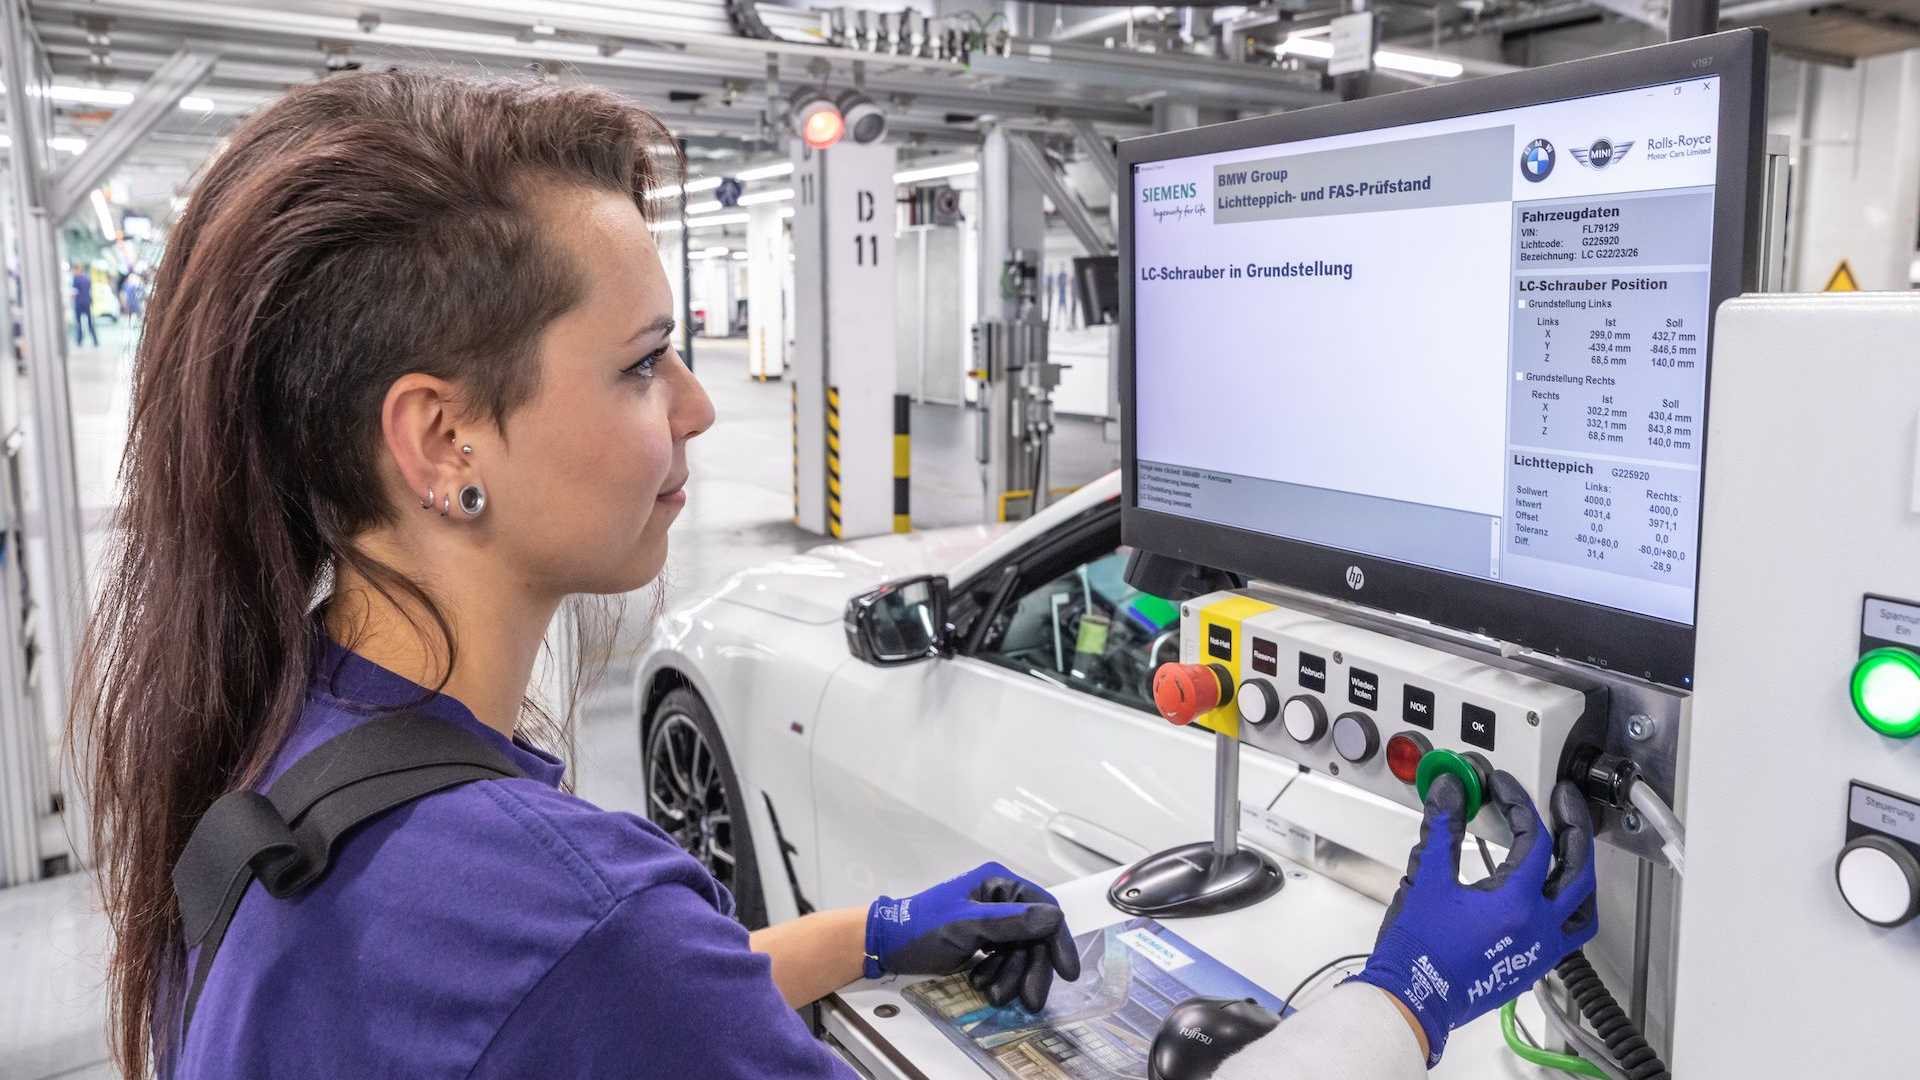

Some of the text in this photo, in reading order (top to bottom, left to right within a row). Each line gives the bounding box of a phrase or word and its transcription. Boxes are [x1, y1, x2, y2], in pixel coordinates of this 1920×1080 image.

[1647, 135, 1712, 150] Rolls-Royce
[1590, 148, 1611, 160] MINI
[1218, 169, 1288, 187] BMW Group
[1142, 182, 1197, 203] SIEMENS
[1217, 175, 1432, 210] Lichtteppich- und FAS-Prüfstand
[858, 190, 874, 222] D
[1521, 206, 1620, 224] Fahrzeugdaten
[1521, 223, 1620, 237] VIN: FL79129
[855, 234, 878, 266] 11
[1520, 236, 1620, 250] Lichtcode: G225920
[1520, 247, 1639, 262] Bezeichnung: LC G22/23/26
[1141, 260, 1353, 281] LC-Schrauber in Grundstellung
[1519, 278, 1668, 292] LC-Schrauber Position
[1528, 299, 1613, 310] Grundstellung Links
[1537, 317, 1684, 328] Links Ist Soll
[1544, 330, 1696, 342] X 299,0 mm 432,7 mm
[1615, 345, 1631, 353] mm
[1679, 347, 1697, 355] mm
[1610, 358, 1627, 366] mm
[1651, 358, 1675, 369] 140,0
[1677, 360, 1695, 368] mm
[1526, 372, 1616, 386] Grundstellung Rechts
[1531, 390, 1680, 409] Rechts Ist Soll
[1611, 410, 1628, 418] mm
[1674, 415, 1692, 423] mm
[1610, 423, 1627, 431] mm
[1674, 428, 1692, 436] mm
[1607, 435, 1624, 443] mm
[1648, 437, 1672, 448] 140,0
[1673, 441, 1691, 449] mm
[1514, 454, 1650, 481] Lichtteppich G225920
[1585, 482, 1682, 503] Links: Rechts:
[1516, 486, 1679, 517] Sollwert 4000,0 4000,0
[1515, 498, 1678, 531] Istwert 4031,4 3971,1
[1515, 511, 1669, 544] Offset 0,0 0,0
[1515, 523, 1549, 537] Toleranz
[1346, 565, 1365, 590] hp
[1895, 624, 1912, 637] Ein
[1300, 665, 1325, 680] Abbruch
[1351, 676, 1376, 691] Wieder-
[1354, 688, 1372, 700] holen
[1409, 700, 1427, 715] NOK
[1471, 720, 1485, 733] OK
[1865, 796, 1916, 821] Steuerung
[1881, 814, 1897, 827] Ein
[1179, 1027, 1213, 1045] FUJITSU
